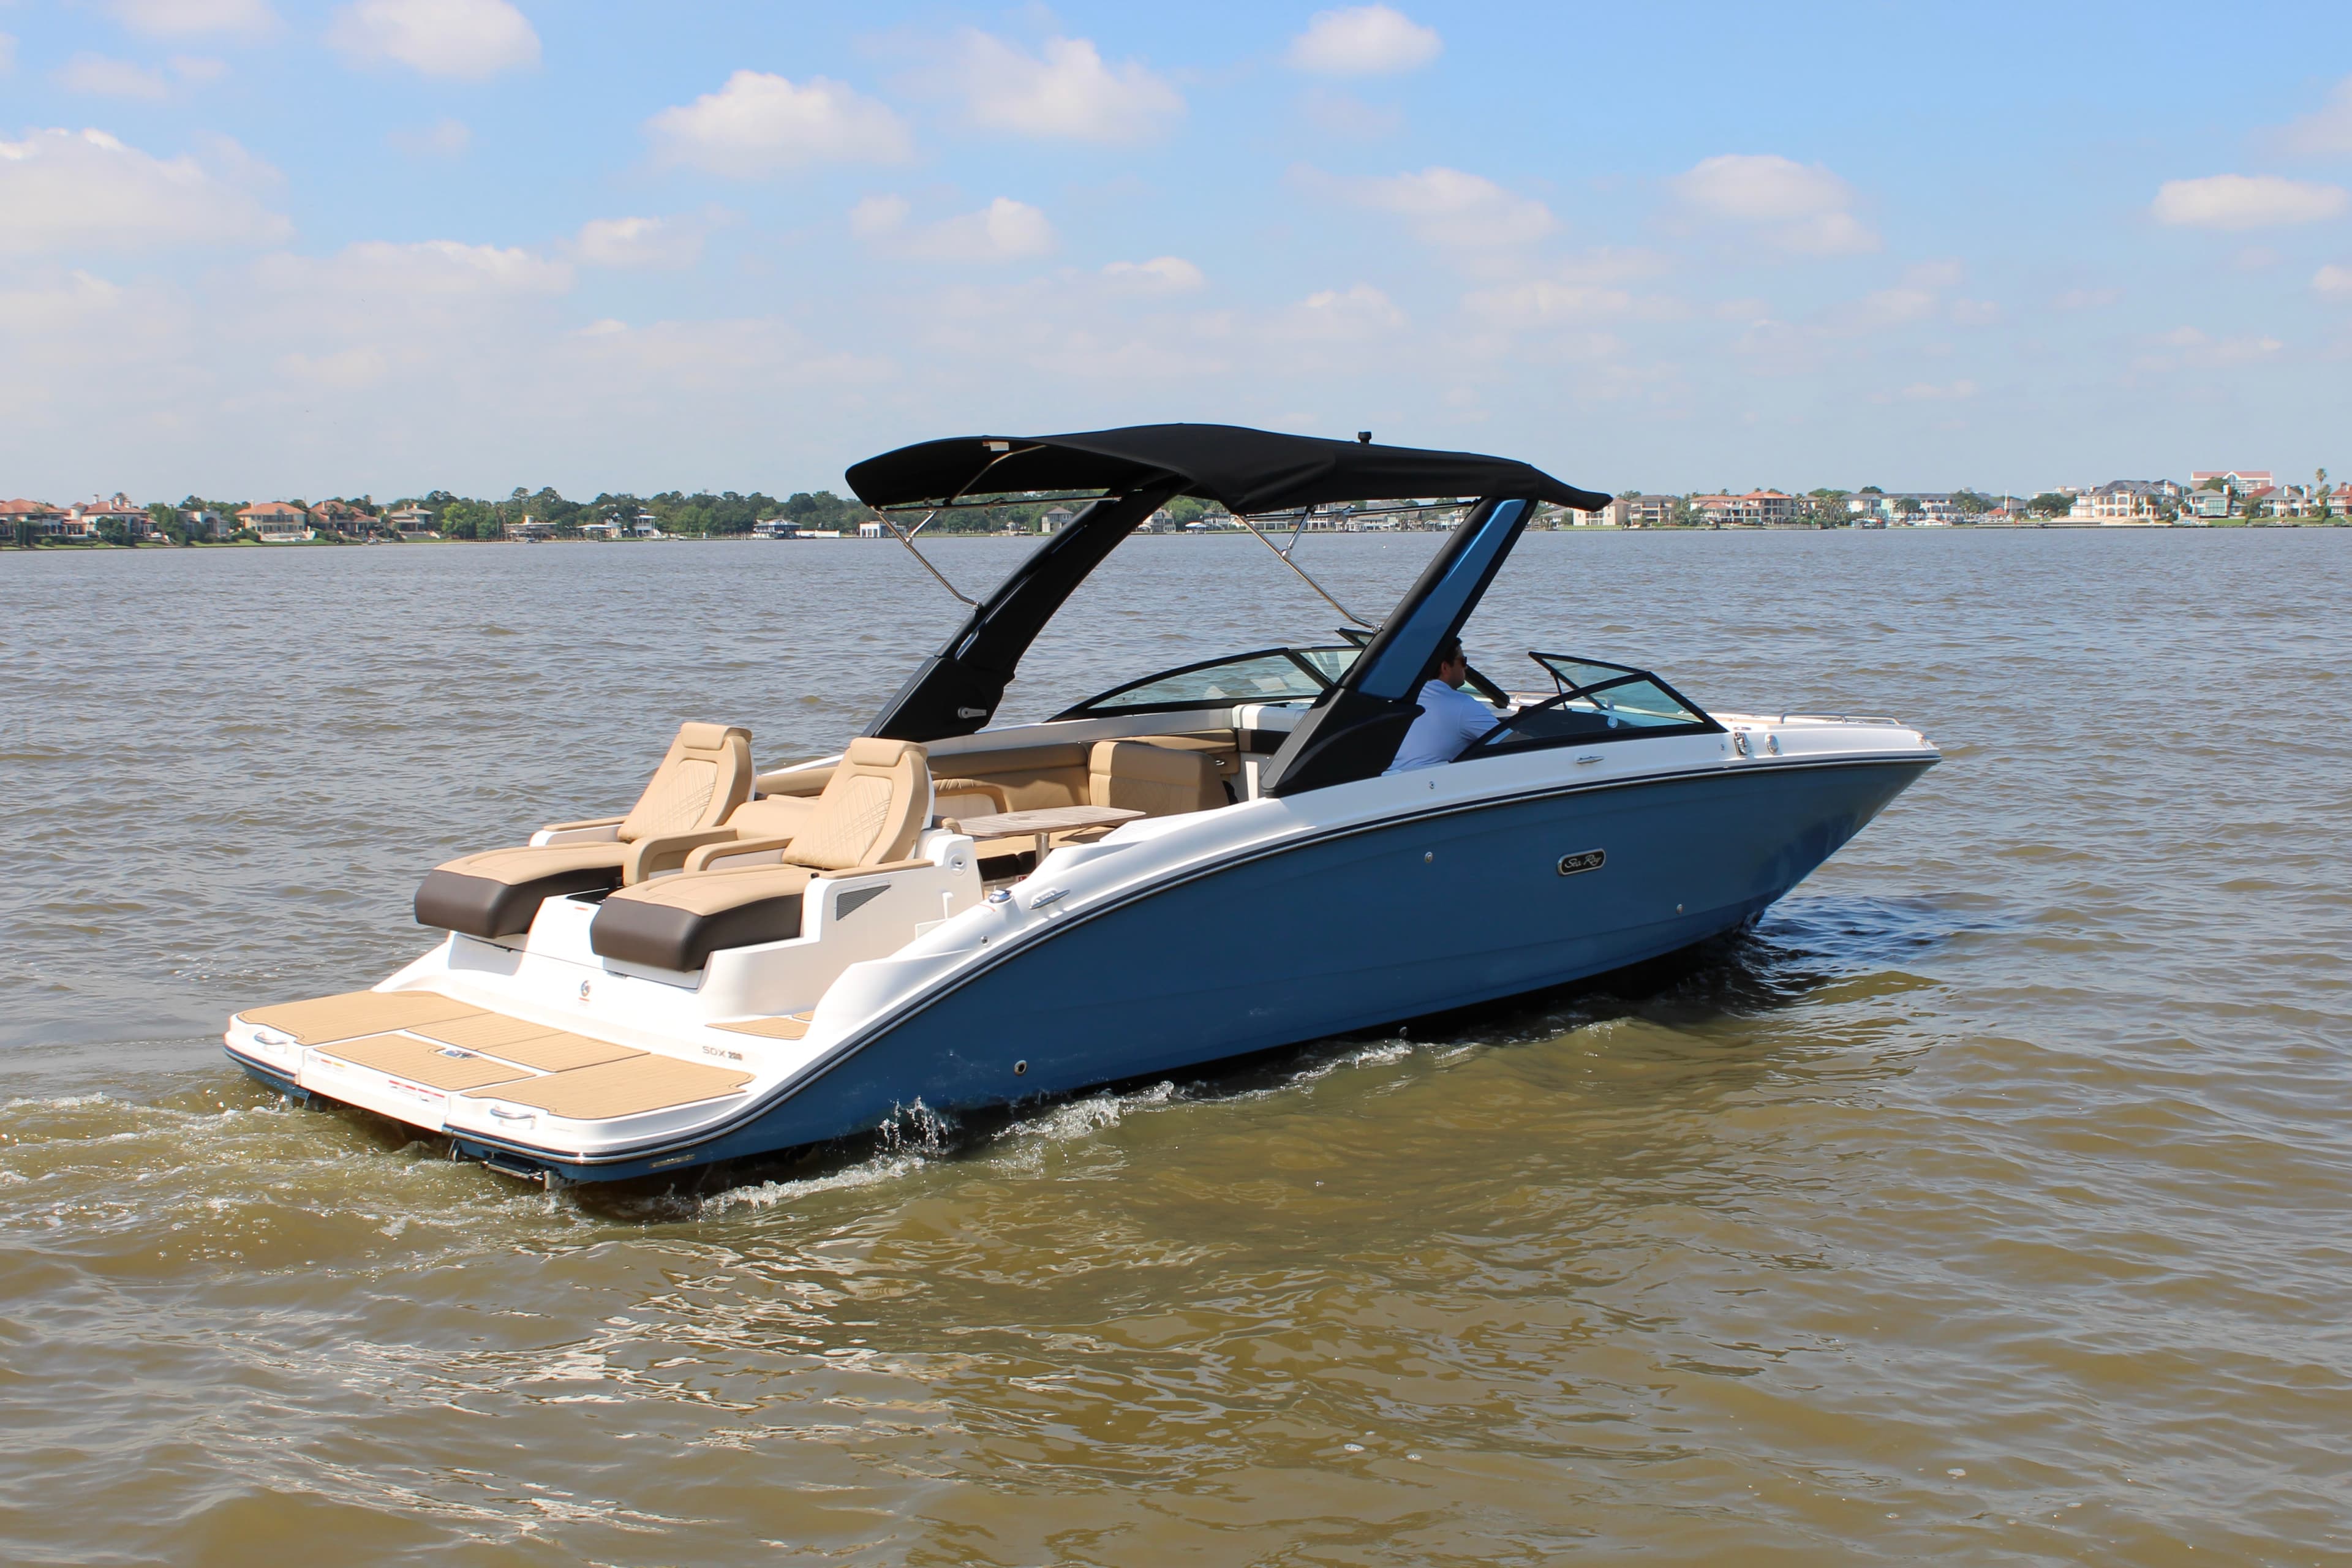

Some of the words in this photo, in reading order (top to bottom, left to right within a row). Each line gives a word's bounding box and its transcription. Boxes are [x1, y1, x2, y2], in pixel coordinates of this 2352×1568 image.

[1564, 858, 1582, 868] Sea
[1583, 854, 1602, 866] Ray
[702, 1046, 726, 1058] SDX
